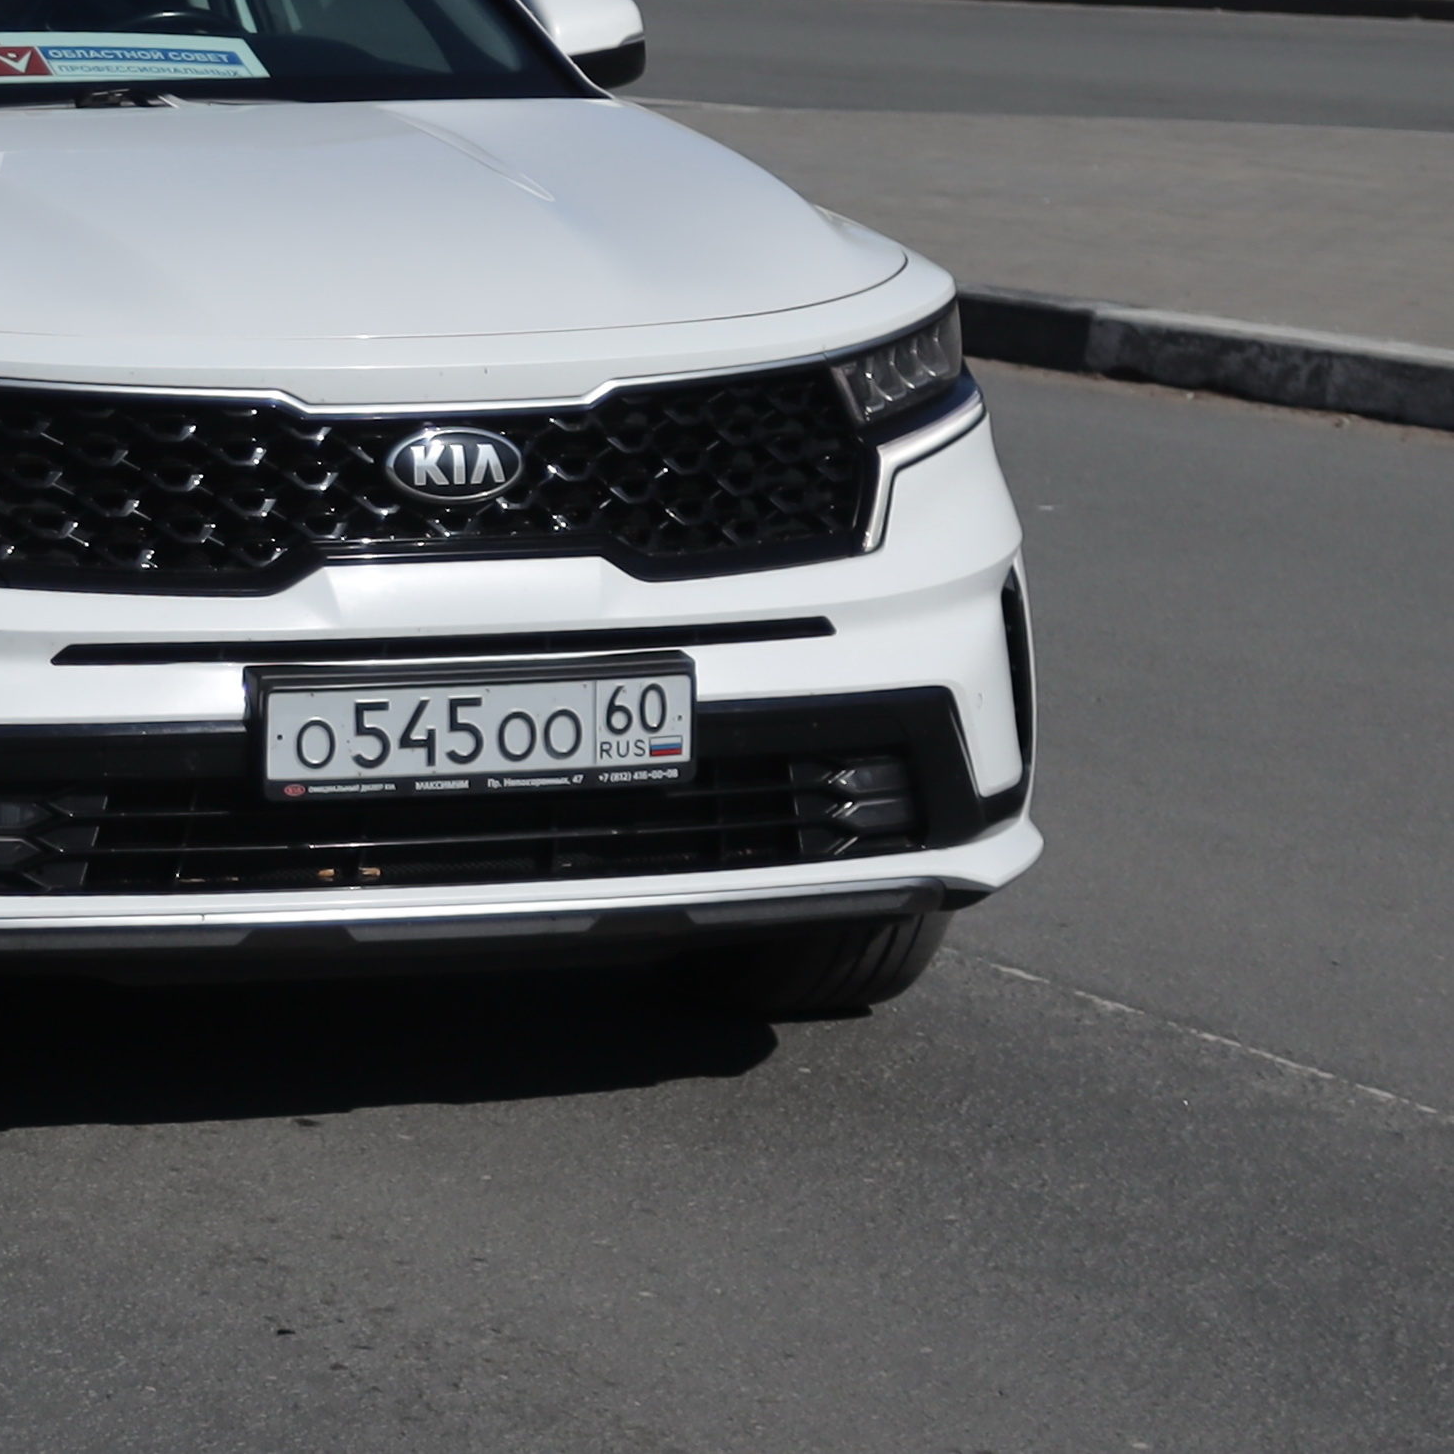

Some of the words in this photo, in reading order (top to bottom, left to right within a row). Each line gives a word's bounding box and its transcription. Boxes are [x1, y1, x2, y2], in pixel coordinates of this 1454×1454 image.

[48, 48, 163, 62] ОБЛАСТНОЙ
[169, 51, 230, 64] СОВЕТ
[57, 64, 241, 77] ПРОФЕССИОНАЛЬНЫХ
[410, 444, 506, 486] KIA
[605, 682, 668, 736] 60
[598, 738, 648, 760] RUS
